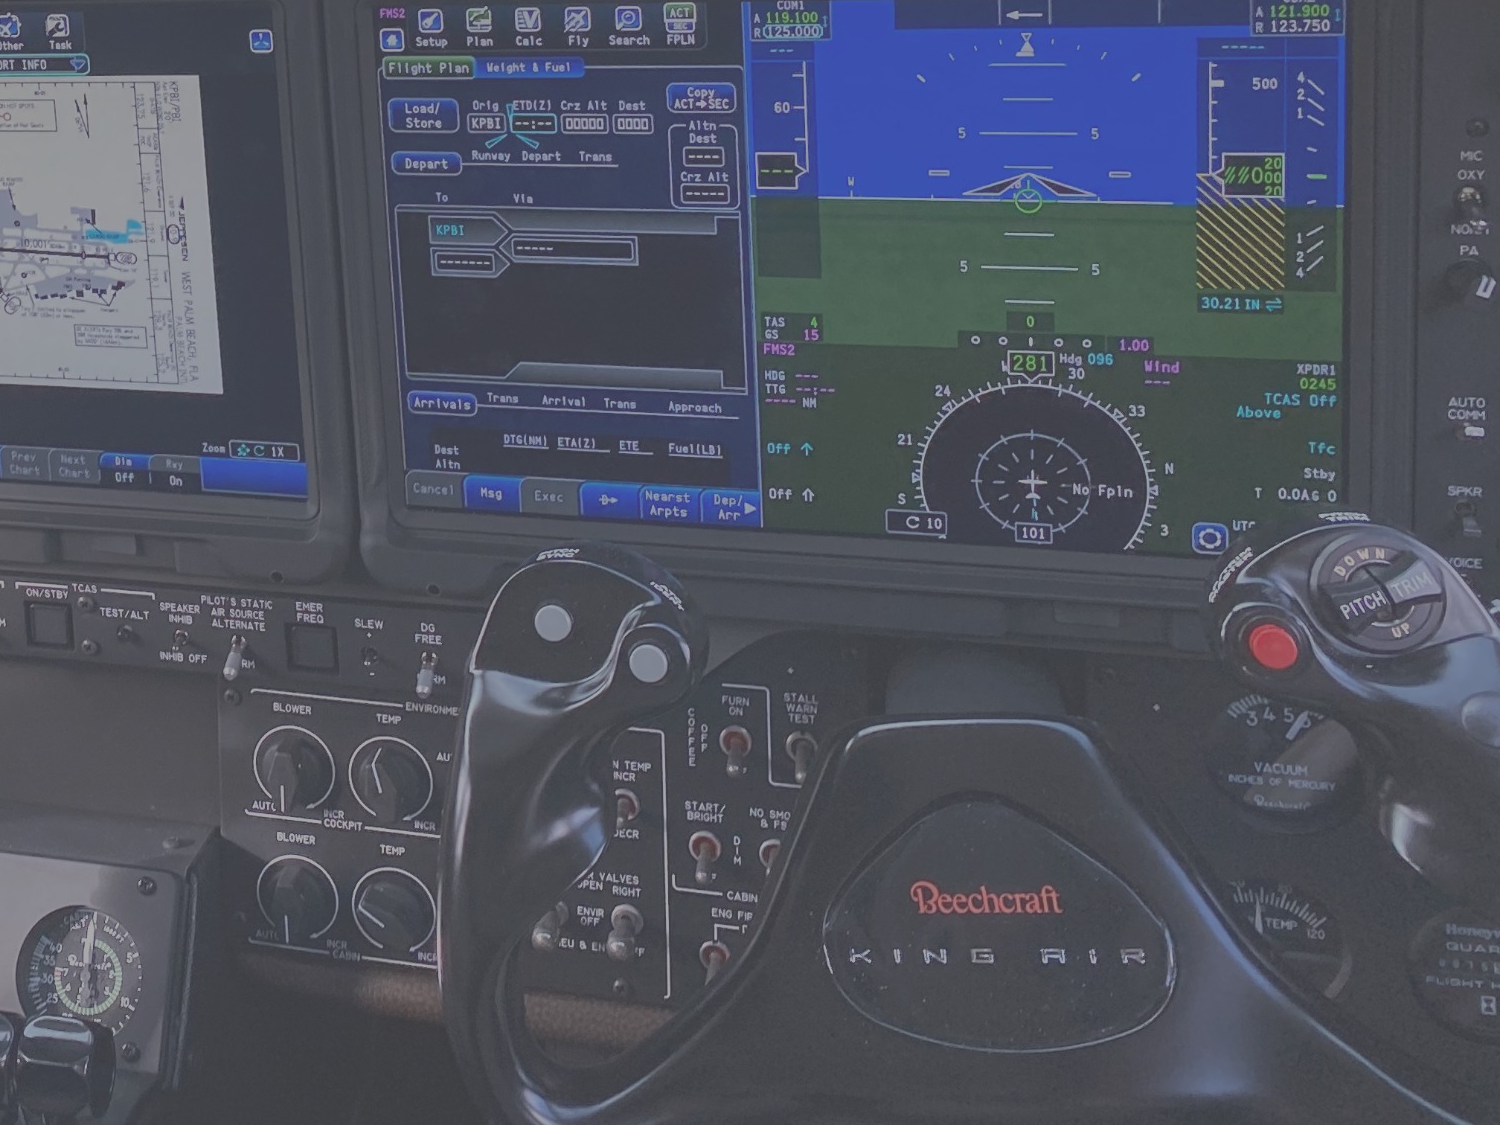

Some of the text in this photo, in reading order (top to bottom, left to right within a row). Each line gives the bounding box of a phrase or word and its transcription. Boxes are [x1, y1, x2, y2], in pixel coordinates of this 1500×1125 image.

[1255, 5, 1330, 17] A 121.900
[753, 12, 818, 23] A 119.100
[49, 39, 72, 51] Task
[415, 36, 448, 49] Setup
[467, 35, 493, 47] Plan
[515, 35, 543, 47] Calc
[568, 34, 589, 47] Fly
[608, 34, 650, 47] Search
[667, 34, 696, 46] FPLN
[21, 59, 48, 71] INFO
[388, 62, 470, 75] Flight Plan
[486, 61, 571, 74] Weight & Fuel
[1252, 78, 1278, 90] 500
[687, 86, 715, 100] Copy
[405, 102, 440, 116] Load/
[472, 100, 499, 113] Orig
[560, 100, 607, 111] Crz Alt
[618, 100, 646, 111] Dest
[773, 102, 790, 113] 60
[405, 117, 442, 129] Store
[688, 120, 717, 131] Altn
[689, 132, 717, 144] Dest
[471, 150, 510, 163] Runway
[521, 150, 561, 163] Depart
[579, 151, 612, 162] Trans
[404, 157, 449, 171] Depart
[680, 171, 729, 183] Crz Alt
[1457, 169, 1486, 180] OXY
[435, 192, 449, 203] To
[513, 194, 534, 205] Via
[436, 225, 466, 236] KPBI
[1460, 245, 1479, 255] PA
[764, 343, 795, 355] FMS2
[1013, 355, 1048, 370] 281
[1059, 354, 1114, 366] Hdg 096
[1144, 360, 1180, 374] Wind
[764, 370, 785, 381] HDG
[1068, 369, 1085, 380] 30
[765, 384, 786, 394] TTG
[1300, 378, 1336, 390] 0245
[413, 395, 471, 411] Arrivals
[487, 392, 519, 405] Trans
[541, 395, 586, 408] Arrival
[603, 398, 637, 410] Trans
[1264, 393, 1337, 407] TCAS Off
[1448, 397, 1486, 409] AUTO
[668, 401, 722, 415] Approach
[1128, 405, 1146, 417] 33
[1236, 406, 1282, 419] Above
[619, 440, 640, 452] ETE
[1303, 468, 1336, 481] Stby
[413, 482, 455, 497] Cancel
[1447, 486, 1482, 498] SPKR
[645, 490, 690, 503] Nearst
[649, 505, 688, 520] Arpts
[717, 509, 741, 521] Arr
[1334, 548, 1386, 578] DOWN
[1339, 573, 1434, 620] PITCH TRIM
[159, 601, 201, 614] SPEAKER
[295, 601, 323, 613] EMER
[296, 613, 325, 624] FREQ
[354, 618, 384, 631] SLEW
[211, 618, 266, 632] ALTERNATE
[420, 622, 436, 633] DG
[1391, 622, 1410, 638] UP
[414, 633, 443, 646] FREE
[783, 693, 818, 705] STALL
[272, 701, 312, 715] BLOWER
[376, 713, 402, 725] TEMP
[787, 712, 816, 726] TEST
[1253, 762, 1309, 776] VACUUM
[414, 820, 436, 831] INCR
[276, 832, 316, 845] BLOWER
[380, 844, 405, 856] TEMP
[612, 886, 642, 900] RIGHT
[909, 878, 1064, 916] Beechcraft
[1265, 918, 1298, 931] TEMP
[1306, 929, 1326, 940] 120
[848, 947, 1147, 966] KING AIR
